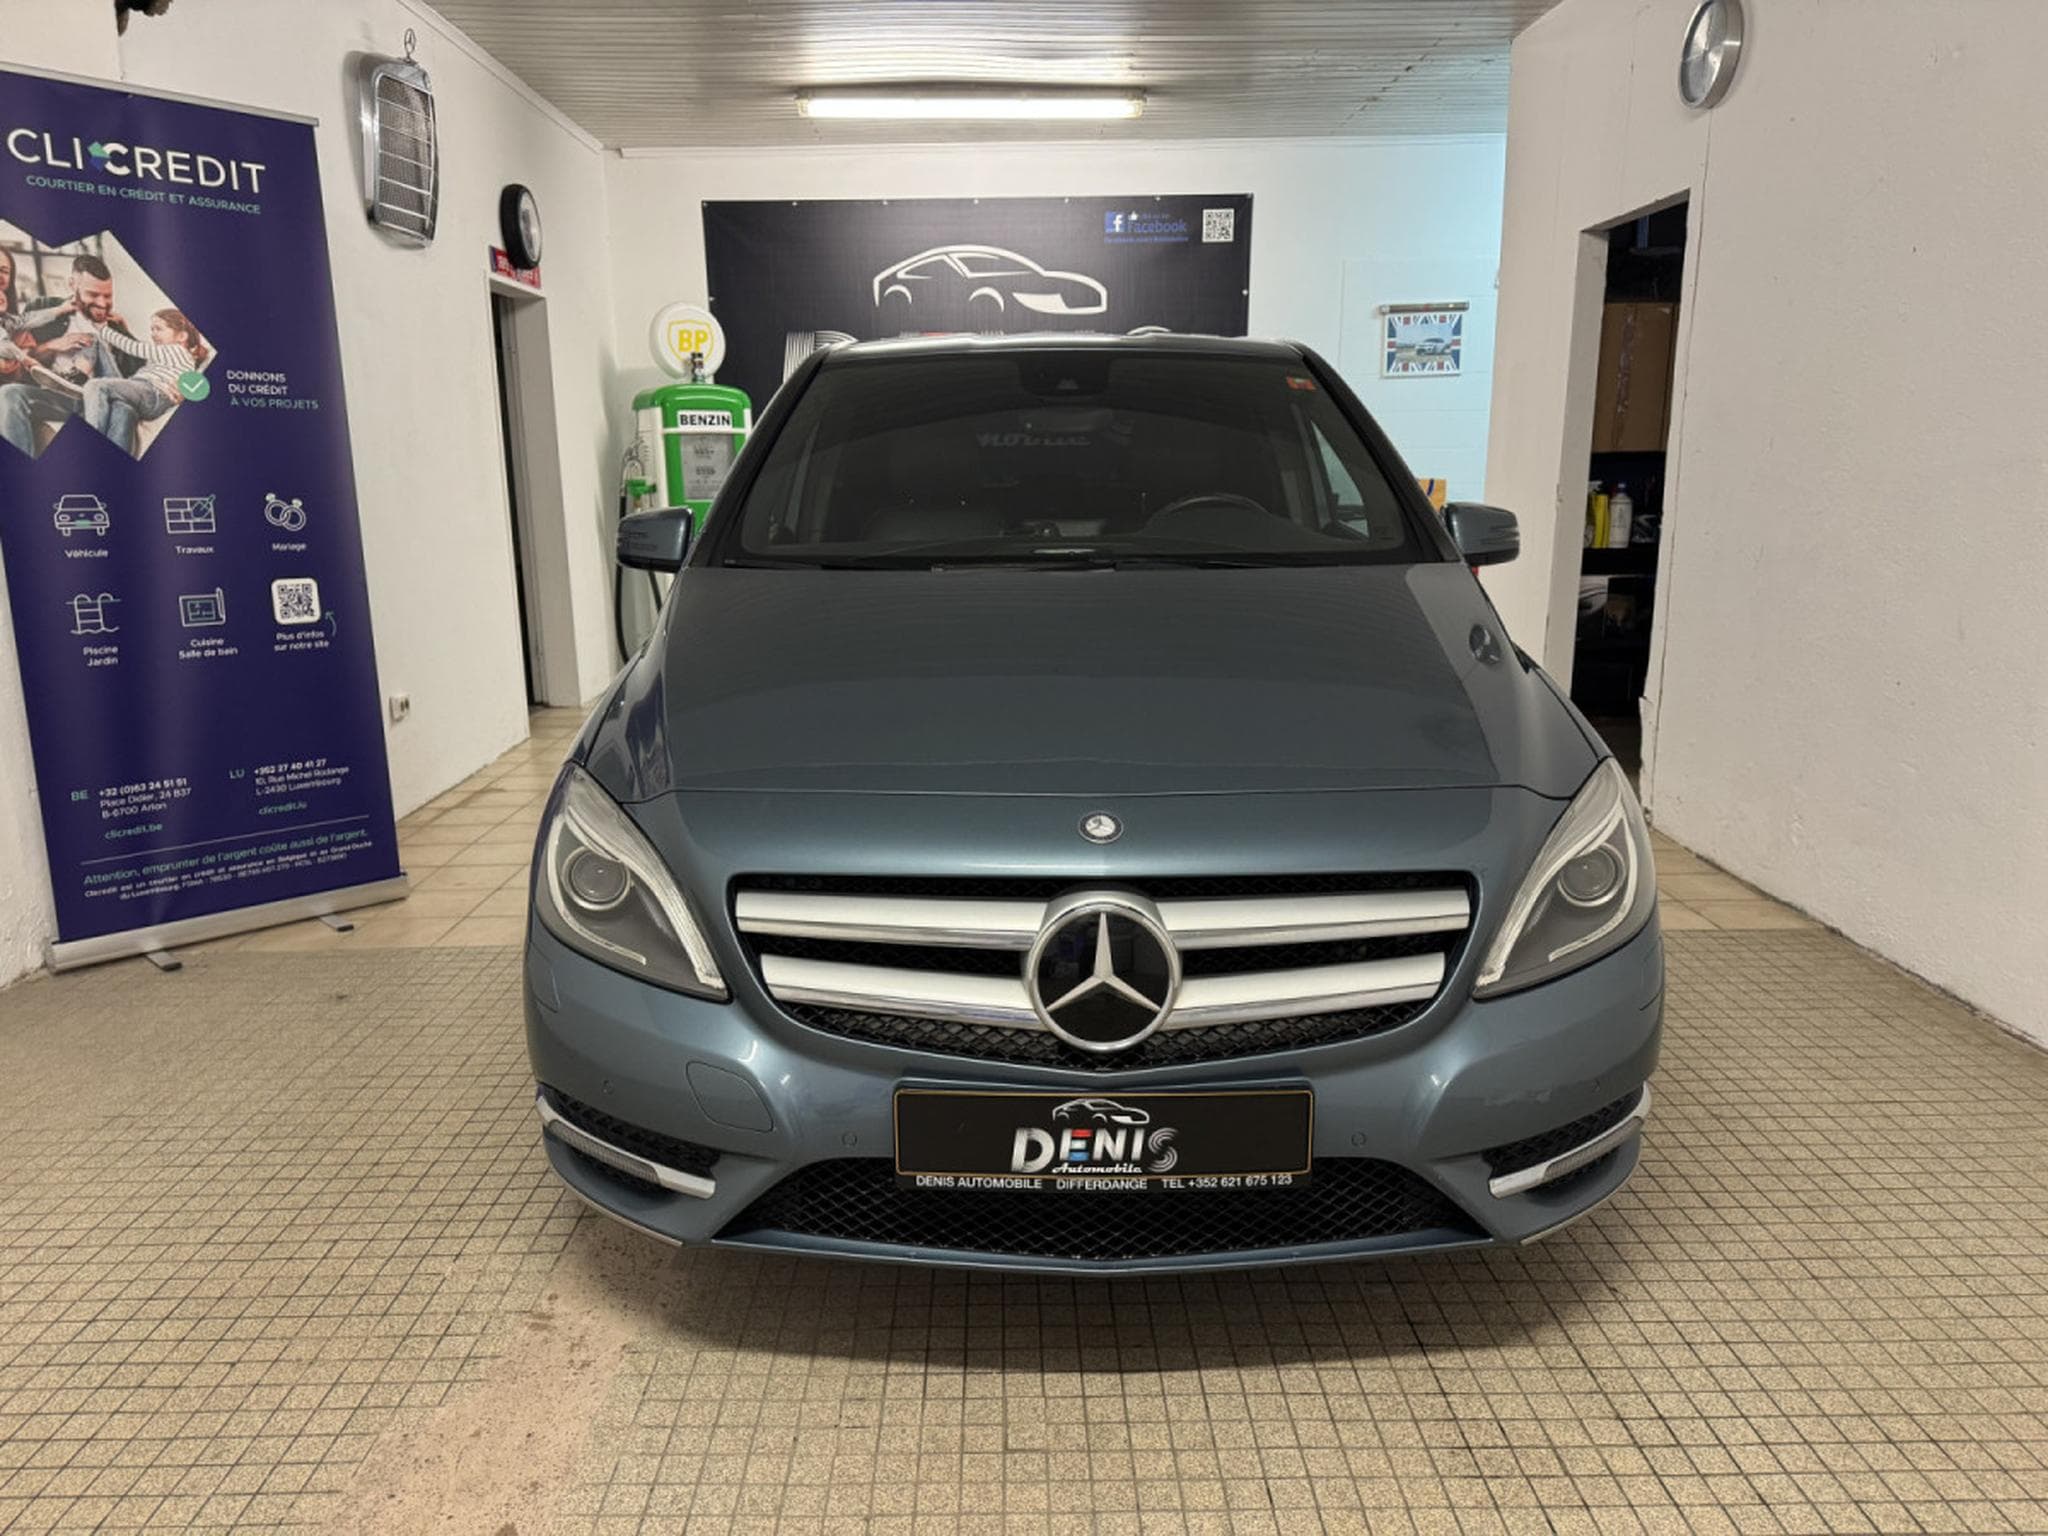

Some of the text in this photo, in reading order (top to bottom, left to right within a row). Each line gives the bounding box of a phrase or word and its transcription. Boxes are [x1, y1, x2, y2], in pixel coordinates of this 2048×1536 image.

[26, 175, 261, 214] COURTIER EN CRÉDIT ET ASSURANCE
[678, 329, 708, 353] BP
[226, 369, 286, 383] DONNONS
[228, 382, 288, 395] DU CRÉDIT
[242, 397, 266, 408] VOS
[268, 398, 319, 410] PROJETS
[679, 414, 731, 426] BENZIN
[175, 545, 214, 554] Travaux
[272, 542, 306, 552] Mariage
[190, 637, 224, 647] Cuisine
[276, 631, 293, 641] Plus
[83, 646, 118, 656] Piscine
[274, 639, 330, 652] sur notre site
[178, 647, 238, 660] Salle de bain
[87, 656, 118, 667] Jardin
[229, 769, 245, 779] LU
[71, 789, 88, 801] BE
[84, 868, 140, 885] Attention,
[142, 857, 199, 876] emprunter
[202, 854, 216, 865] de
[217, 847, 257, 863] l'argent
[290, 837, 315, 849] aussi
[316, 834, 329, 845] de
[1011, 1127, 1179, 1173] DENIS
[1051, 1161, 1144, 1174] Automobile
[916, 1173, 1293, 1191] DENIS AUTOMOBILE DIFFERDANGE TEL +352 621 675 123
